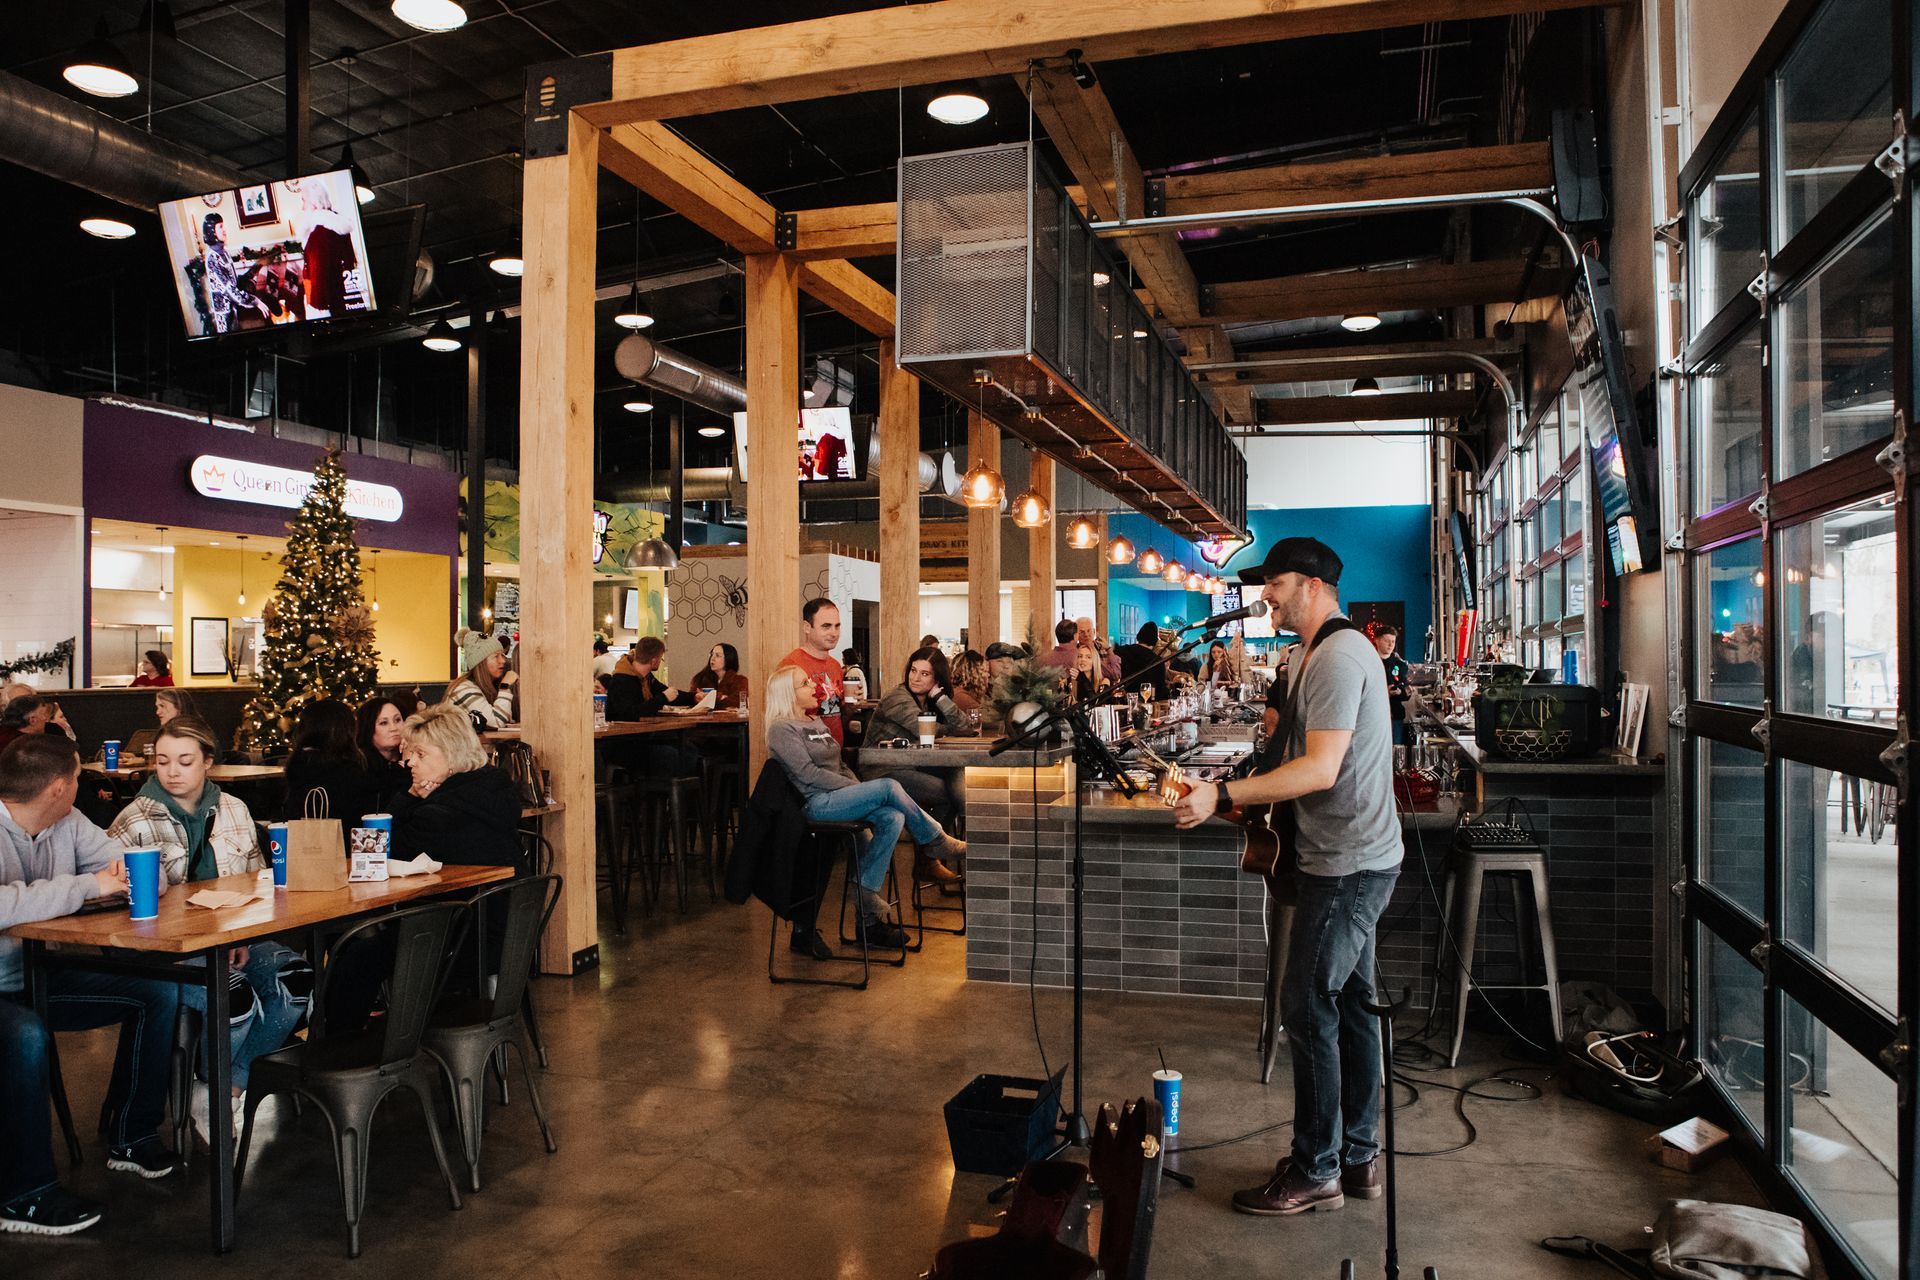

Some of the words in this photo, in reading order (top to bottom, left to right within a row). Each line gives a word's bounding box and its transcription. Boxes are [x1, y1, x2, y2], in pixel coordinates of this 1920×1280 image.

[342, 269, 360, 286] 25
[233, 469, 282, 492] Queen
[349, 487, 395, 511] Kitchen
[271, 857, 285, 865] epsi
[1170, 1091, 1179, 1123] pepsi
